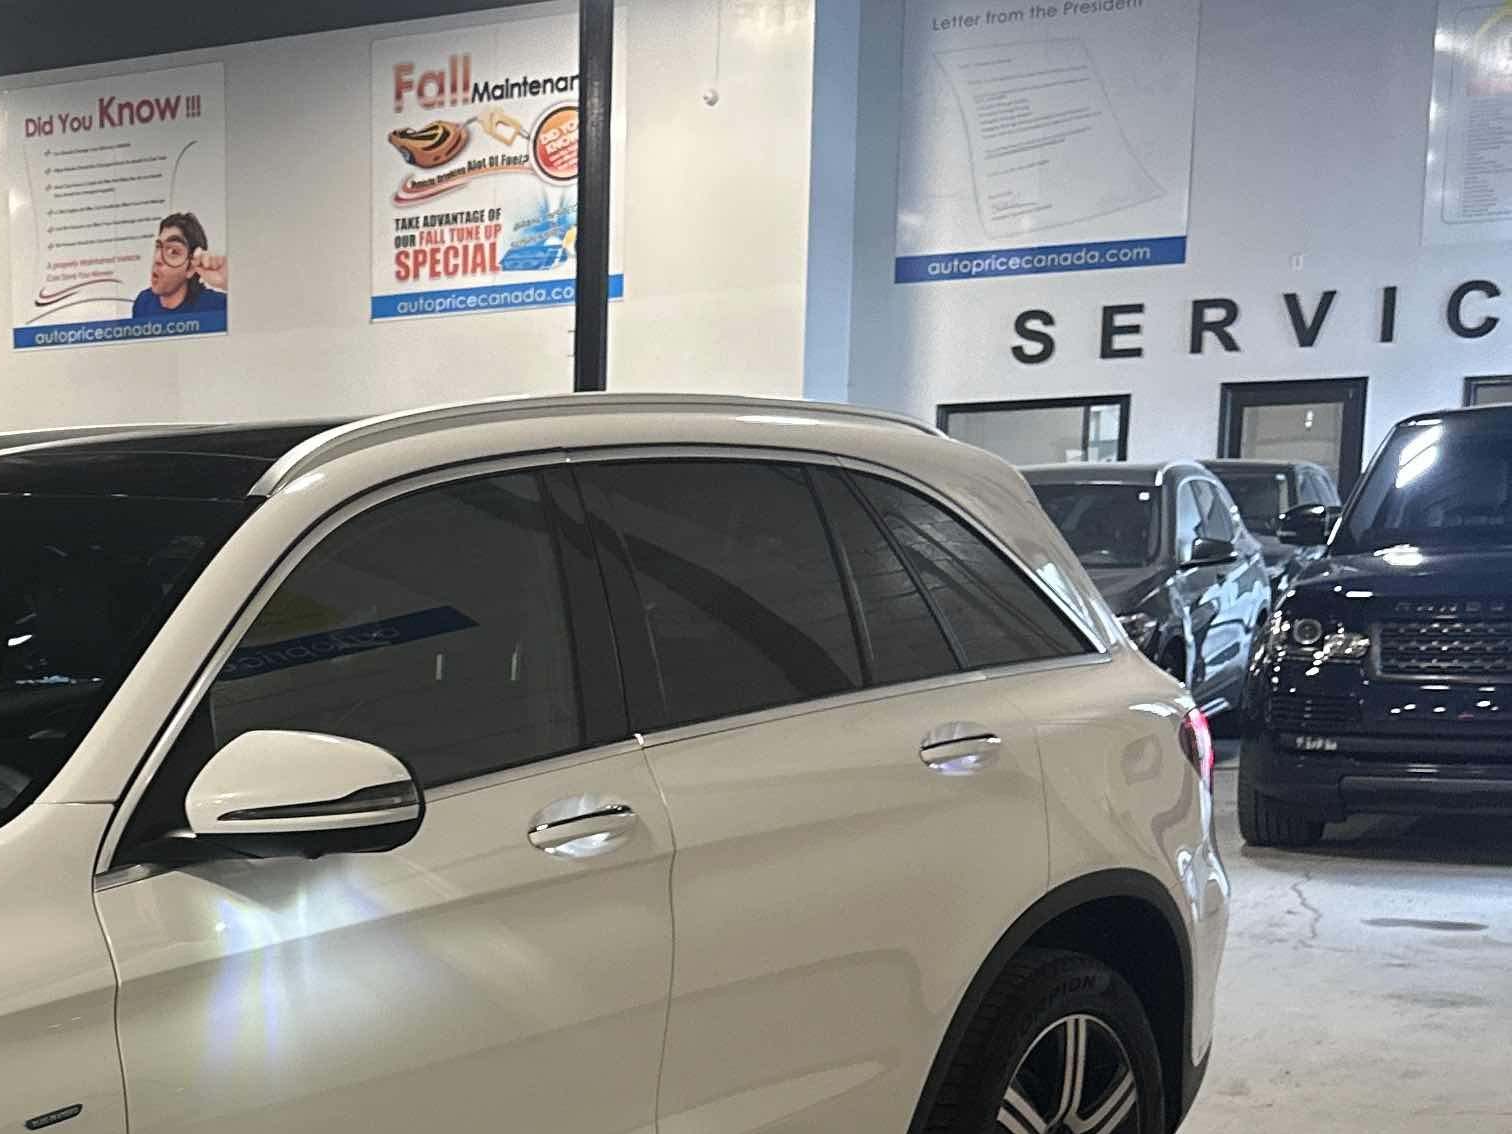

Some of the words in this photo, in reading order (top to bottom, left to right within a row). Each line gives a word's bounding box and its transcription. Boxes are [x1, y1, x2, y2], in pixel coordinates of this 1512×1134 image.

[932, 15, 981, 31] Letter
[987, 11, 1024, 24] from
[1030, 4, 1058, 18] the
[393, 53, 472, 113] Fall
[25, 115, 54, 137] Did
[58, 112, 92, 132] You
[98, 95, 182, 128] Know
[186, 94, 202, 118] !!!
[395, 217, 420, 231] TAKE
[422, 210, 486, 228] ADVANTAGE
[488, 208, 502, 222] OF
[394, 235, 416, 249] OUR
[419, 230, 445, 246] FALL
[449, 227, 481, 243] TUNE
[484, 224, 502, 241] UP
[394, 243, 501, 283] SPECIAL
[927, 245, 1151, 277] autopricecanada.com
[34, 318, 200, 346] autopricecanada.com
[1011, 280, 1501, 365] SERVIC
